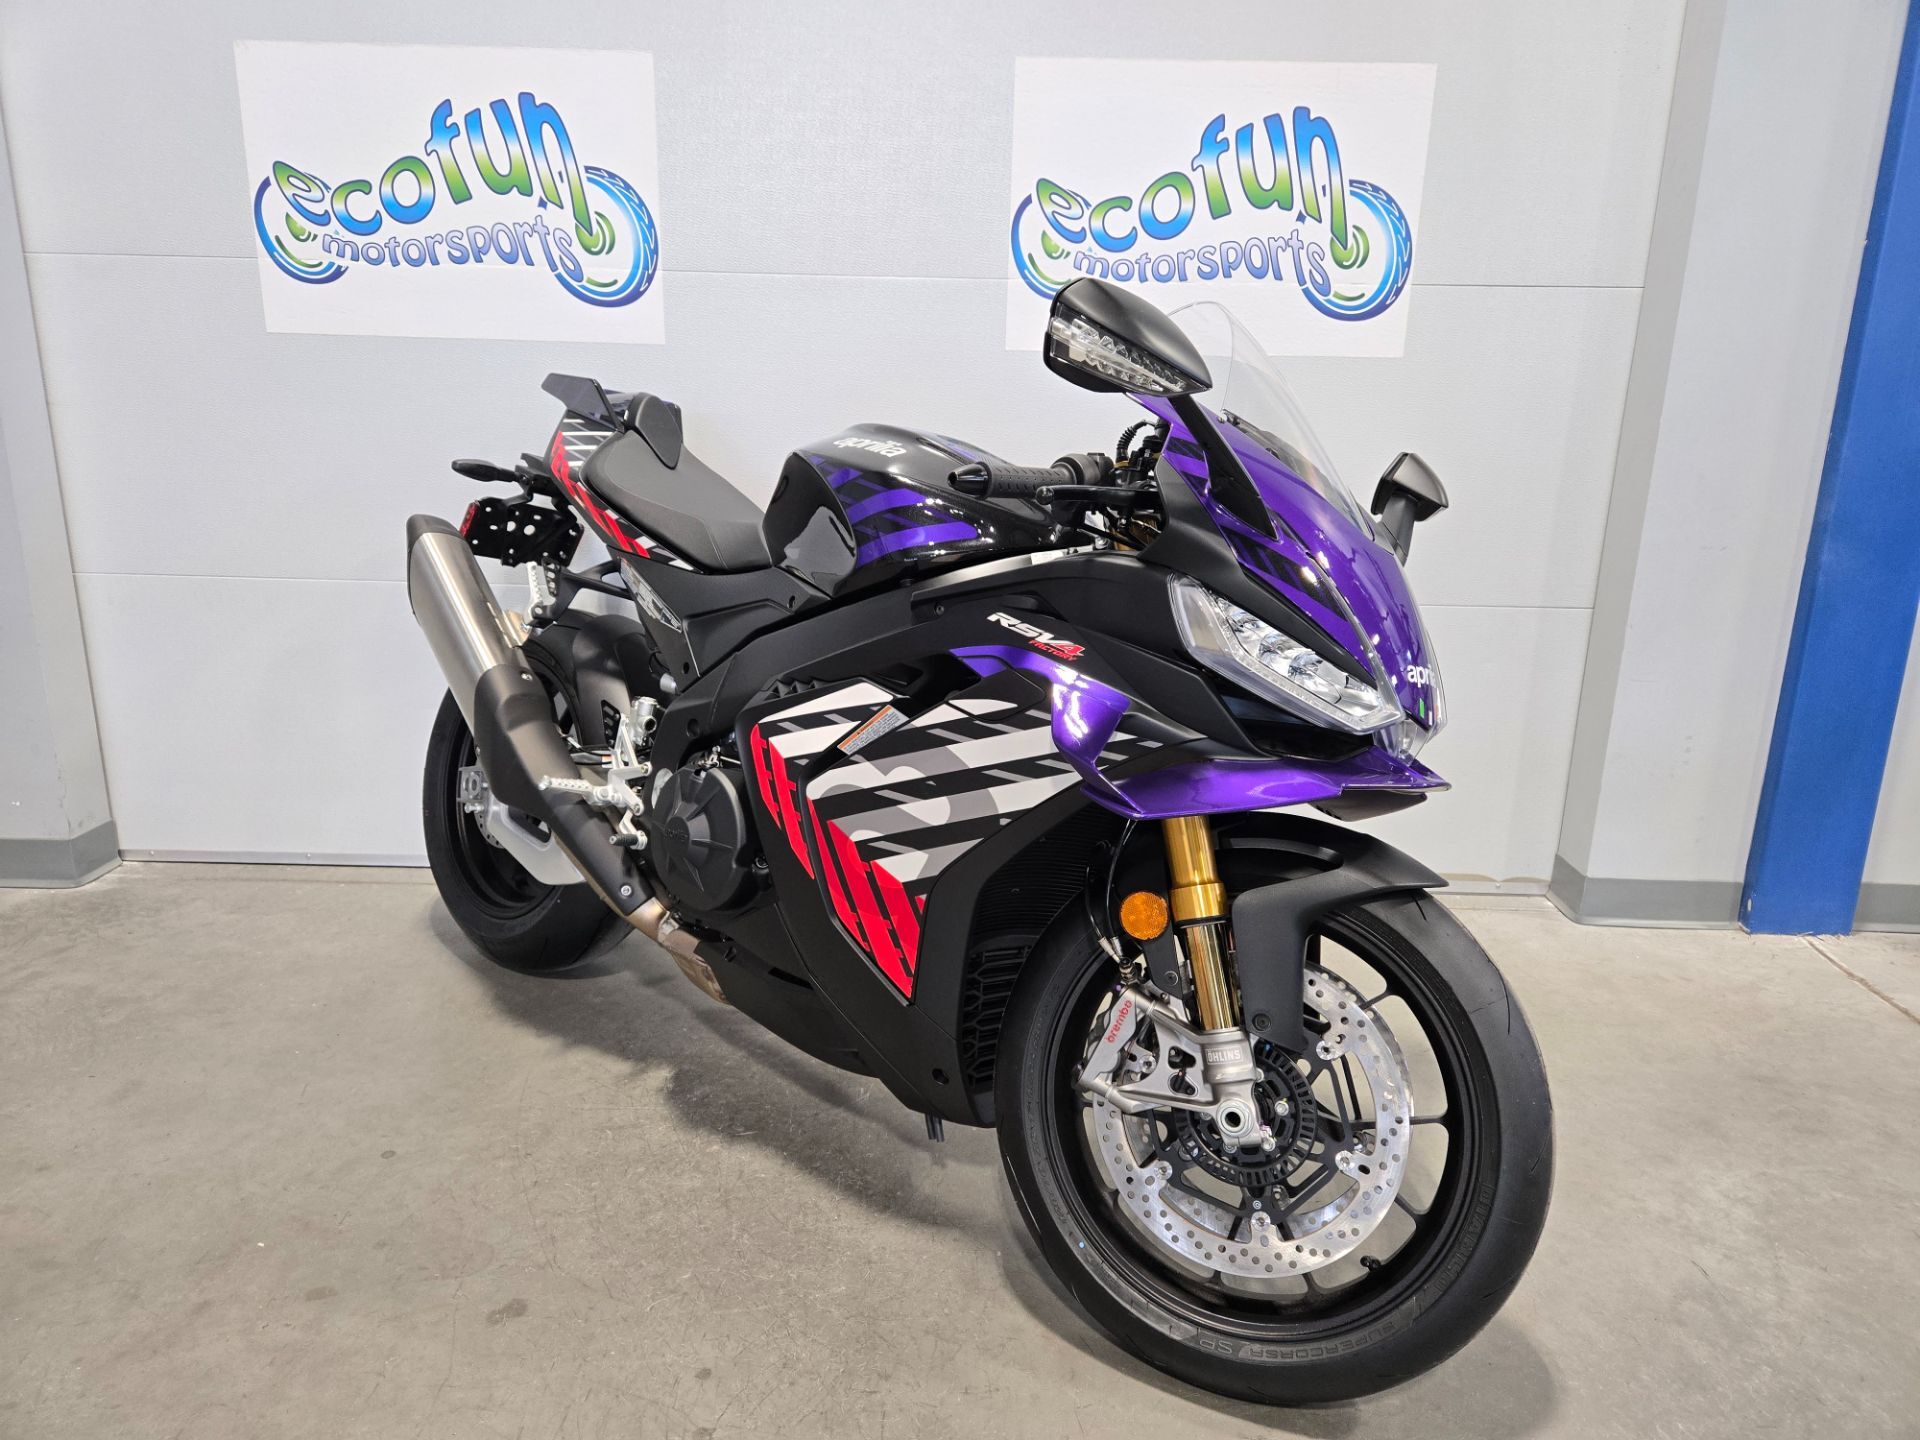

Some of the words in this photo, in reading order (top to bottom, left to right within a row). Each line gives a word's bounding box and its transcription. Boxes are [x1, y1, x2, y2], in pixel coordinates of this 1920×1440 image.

[273, 92, 594, 237] ecofun
[1036, 105, 1349, 250] ecofun
[322, 214, 584, 283] motorsports
[1073, 229, 1332, 298] motorsports
[1104, 1000, 1133, 1043] brembo
